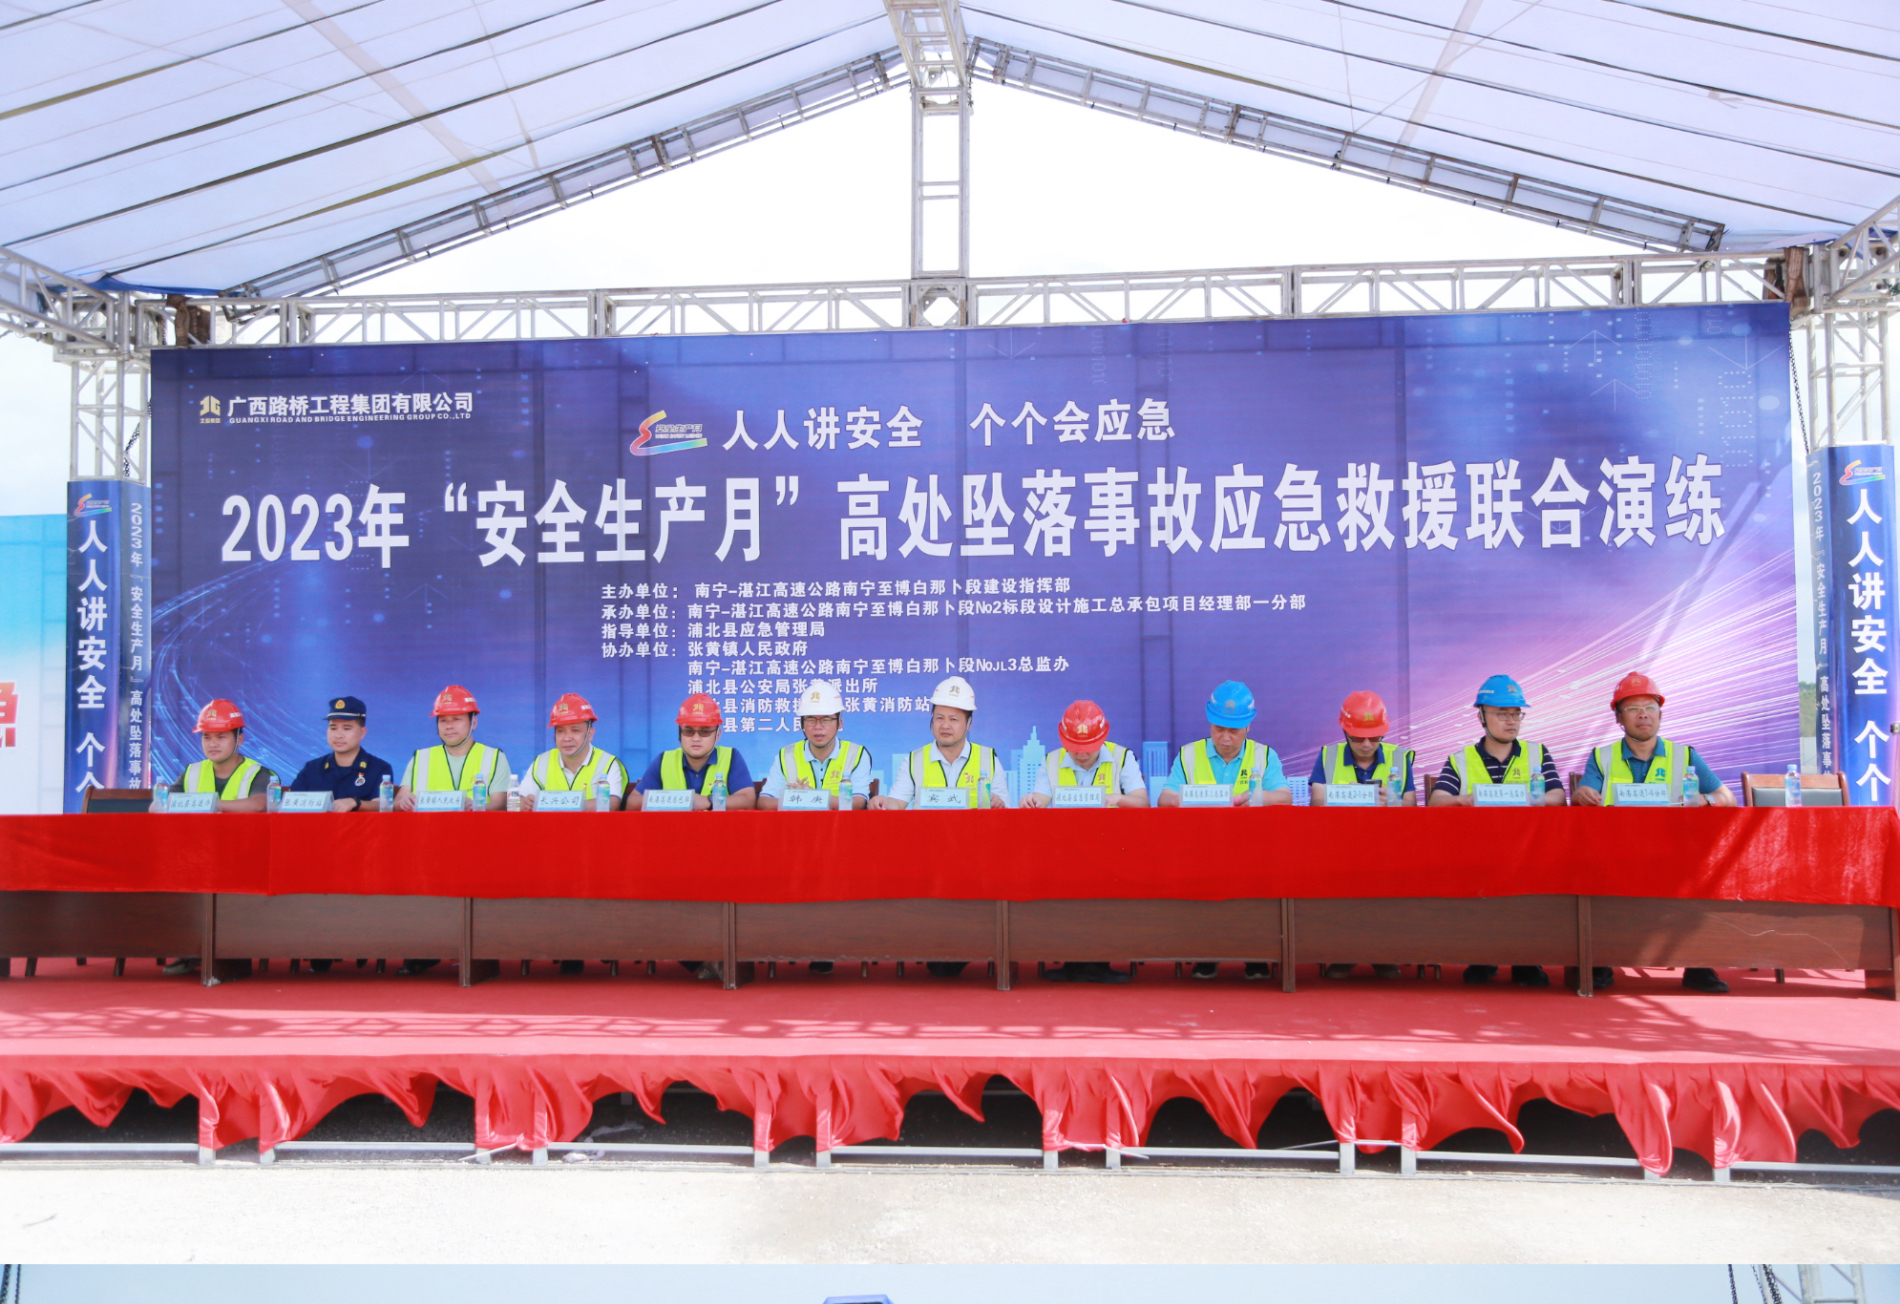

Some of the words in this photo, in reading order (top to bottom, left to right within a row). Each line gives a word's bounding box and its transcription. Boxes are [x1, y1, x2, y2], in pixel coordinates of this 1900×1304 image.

[227, 392, 473, 416] 广西路桥工程集团有限公司
[314, 415, 345, 423] BRIDGE
[347, 414, 405, 422] ENGINEERING
[406, 413, 436, 421] GROUP
[722, 405, 924, 452] 人人讲安全
[969, 398, 1175, 447] 个个会应急
[601, 583, 678, 600] 主办单位：
[1847, 489, 1888, 695] 人人讲安全
[76, 519, 108, 709] 人人讲安全
[601, 604, 676, 620] 承办单位：
[601, 623, 676, 639] 指导单位：
[688, 621, 825, 638] 浦北县应急管理局
[602, 641, 676, 658] 协办单位：
[688, 640, 808, 657] 张黄镇人民政府
[1854, 720, 1891, 802] 个个
